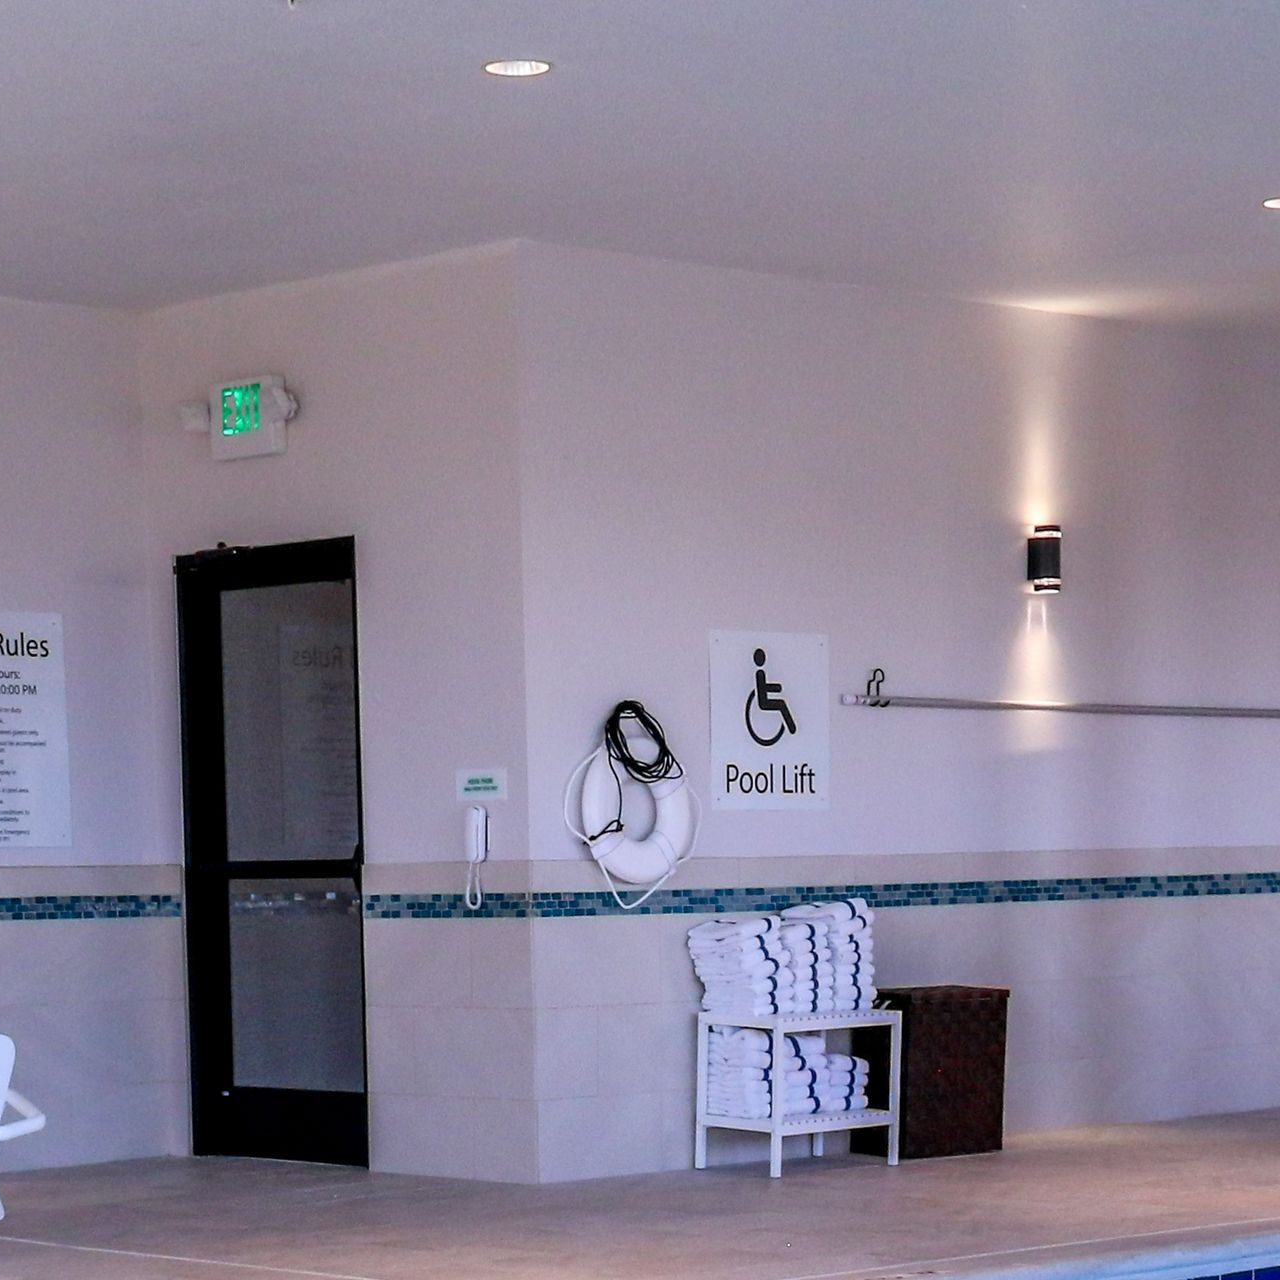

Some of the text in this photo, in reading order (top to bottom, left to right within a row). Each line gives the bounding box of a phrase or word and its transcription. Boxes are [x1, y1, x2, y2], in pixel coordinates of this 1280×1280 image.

[222, 384, 260, 436] EXIT
[22, 685, 38, 695] PM
[726, 763, 816, 794] Pool Lift
